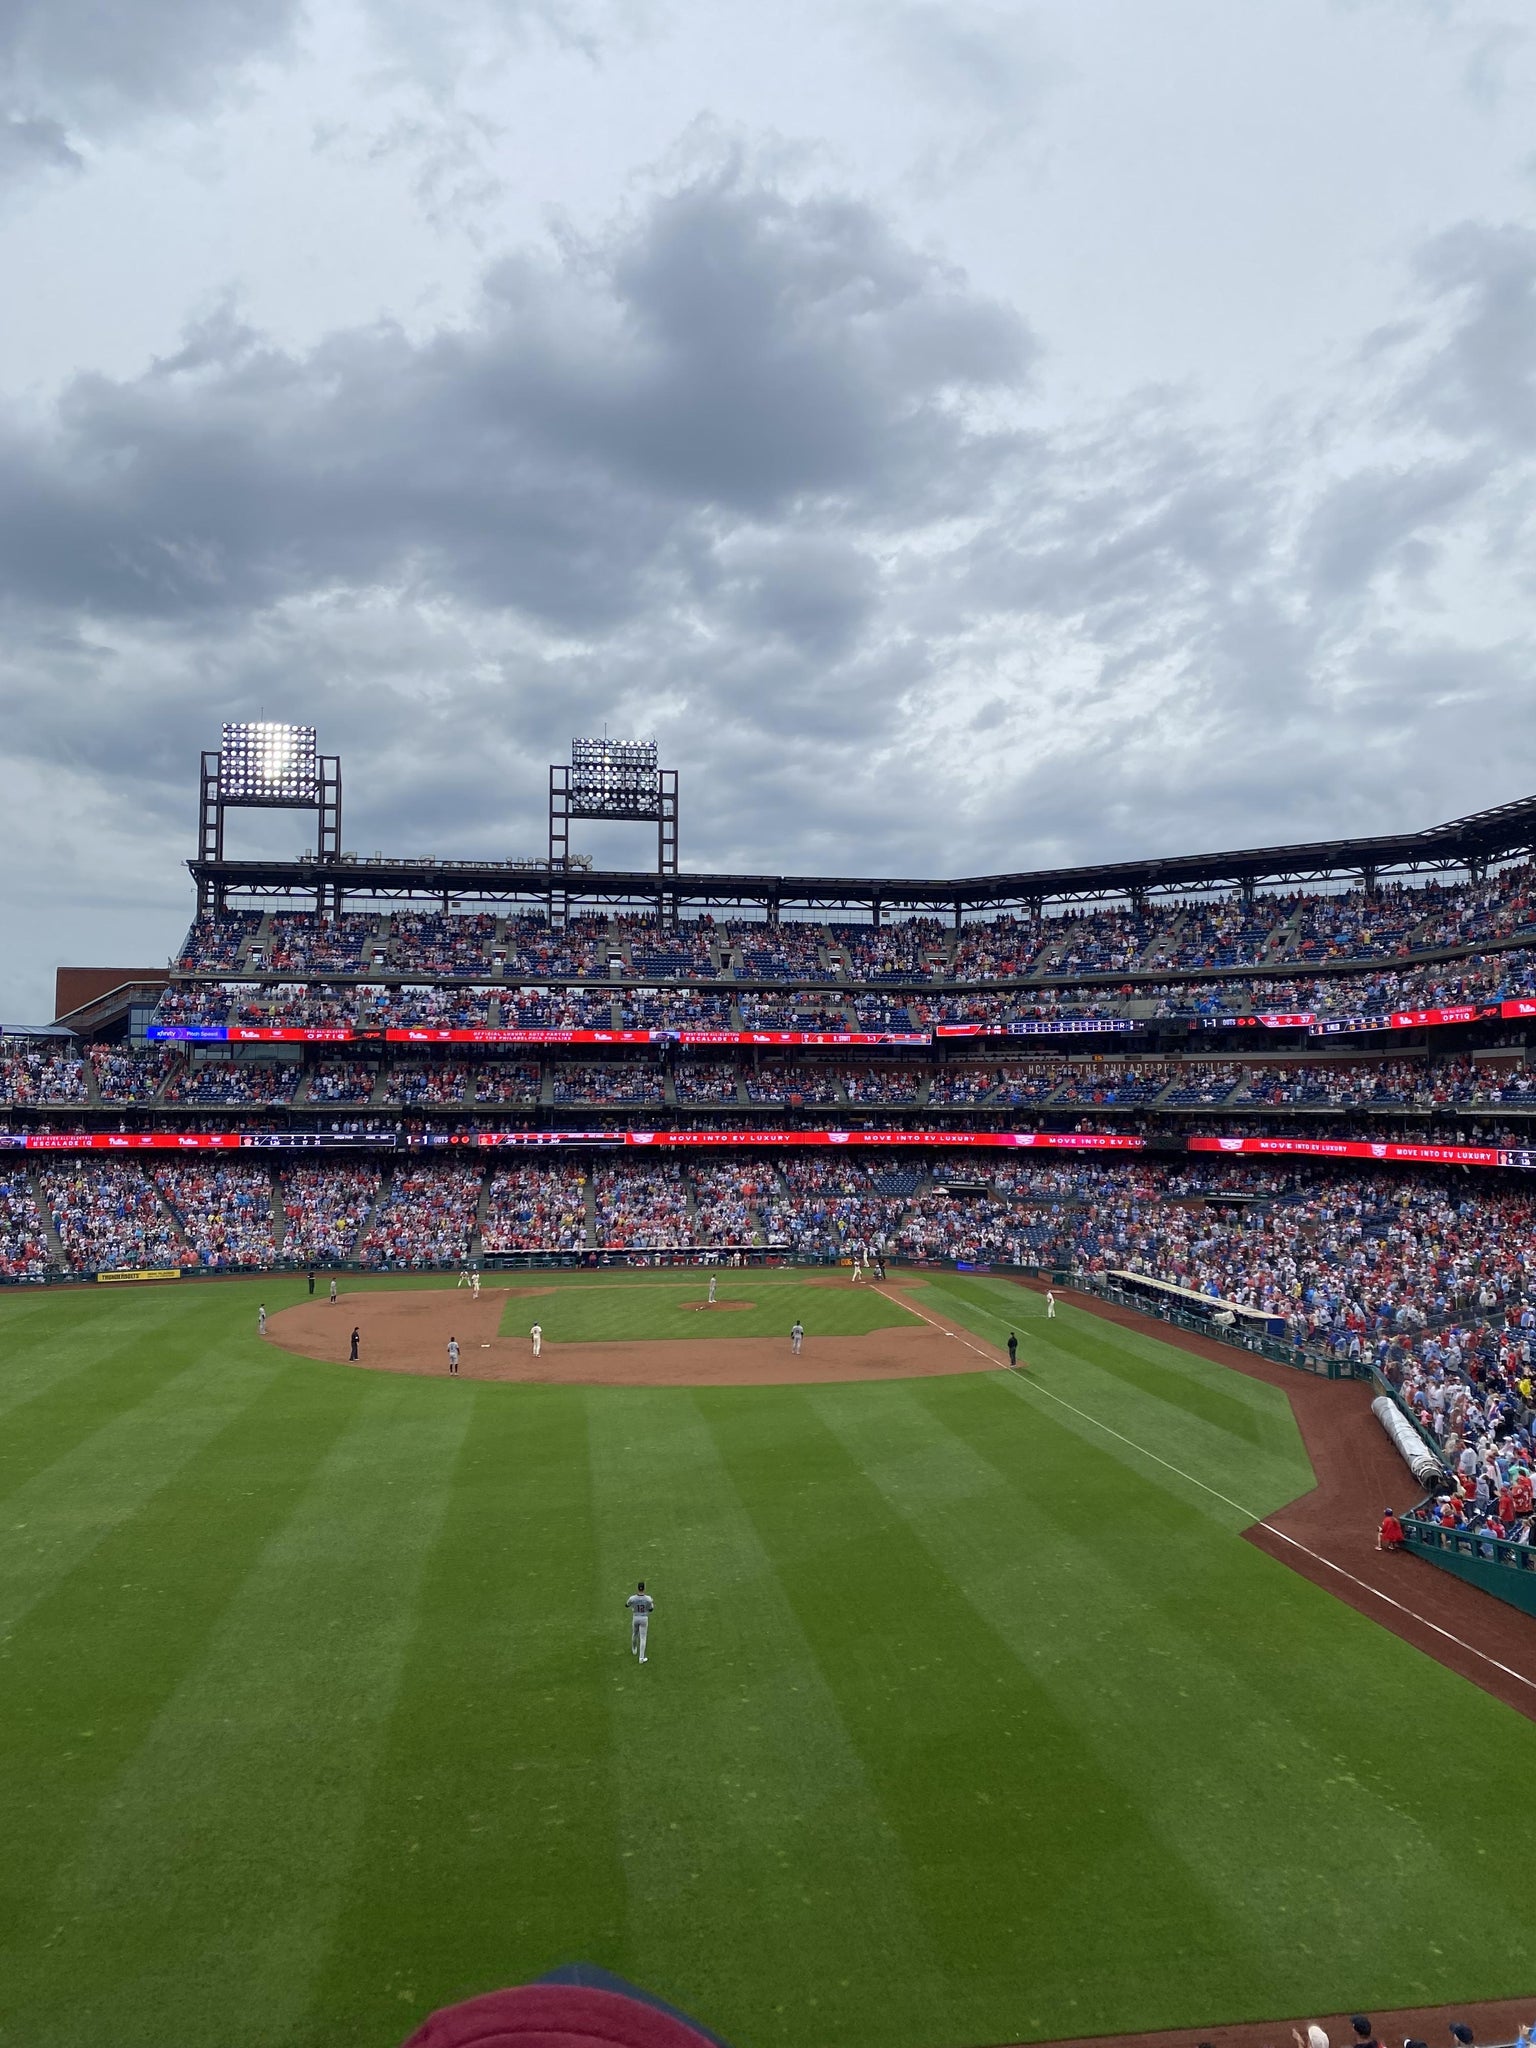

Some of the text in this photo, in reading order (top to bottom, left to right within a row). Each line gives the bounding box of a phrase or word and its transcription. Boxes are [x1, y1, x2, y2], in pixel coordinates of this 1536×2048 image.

[1443, 1013, 1470, 1021] OPTIQ
[1203, 1019, 1216, 1027] 1-1
[1396, 1148, 1418, 1156] MOVE
[1457, 1152, 1491, 1160] LUXURY
